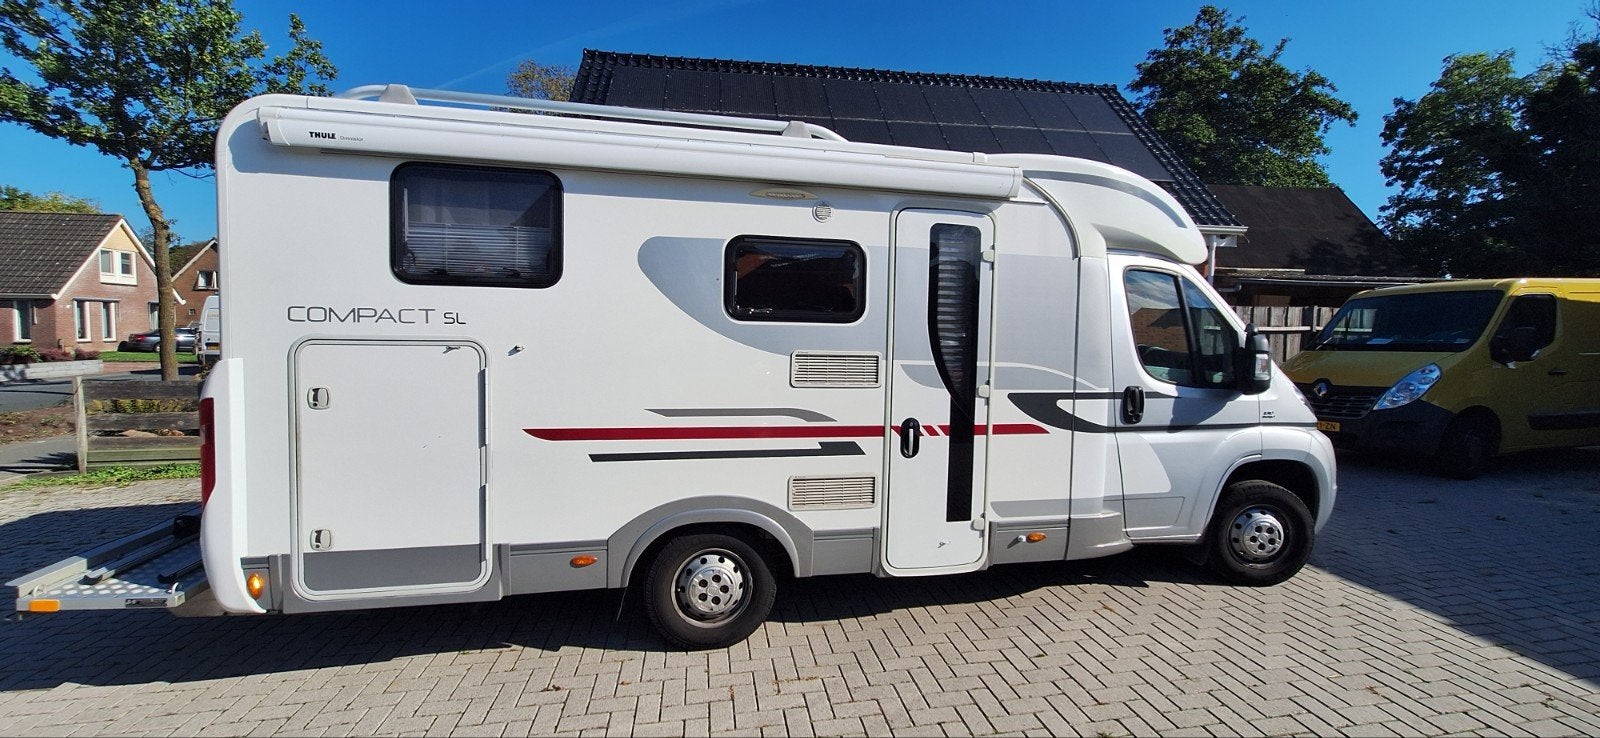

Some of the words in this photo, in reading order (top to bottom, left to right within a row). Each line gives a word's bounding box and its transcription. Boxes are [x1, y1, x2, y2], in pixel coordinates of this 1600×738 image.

[308, 131, 337, 139] THULE
[287, 306, 436, 324] COMPACT
[443, 312, 467, 325] SL
